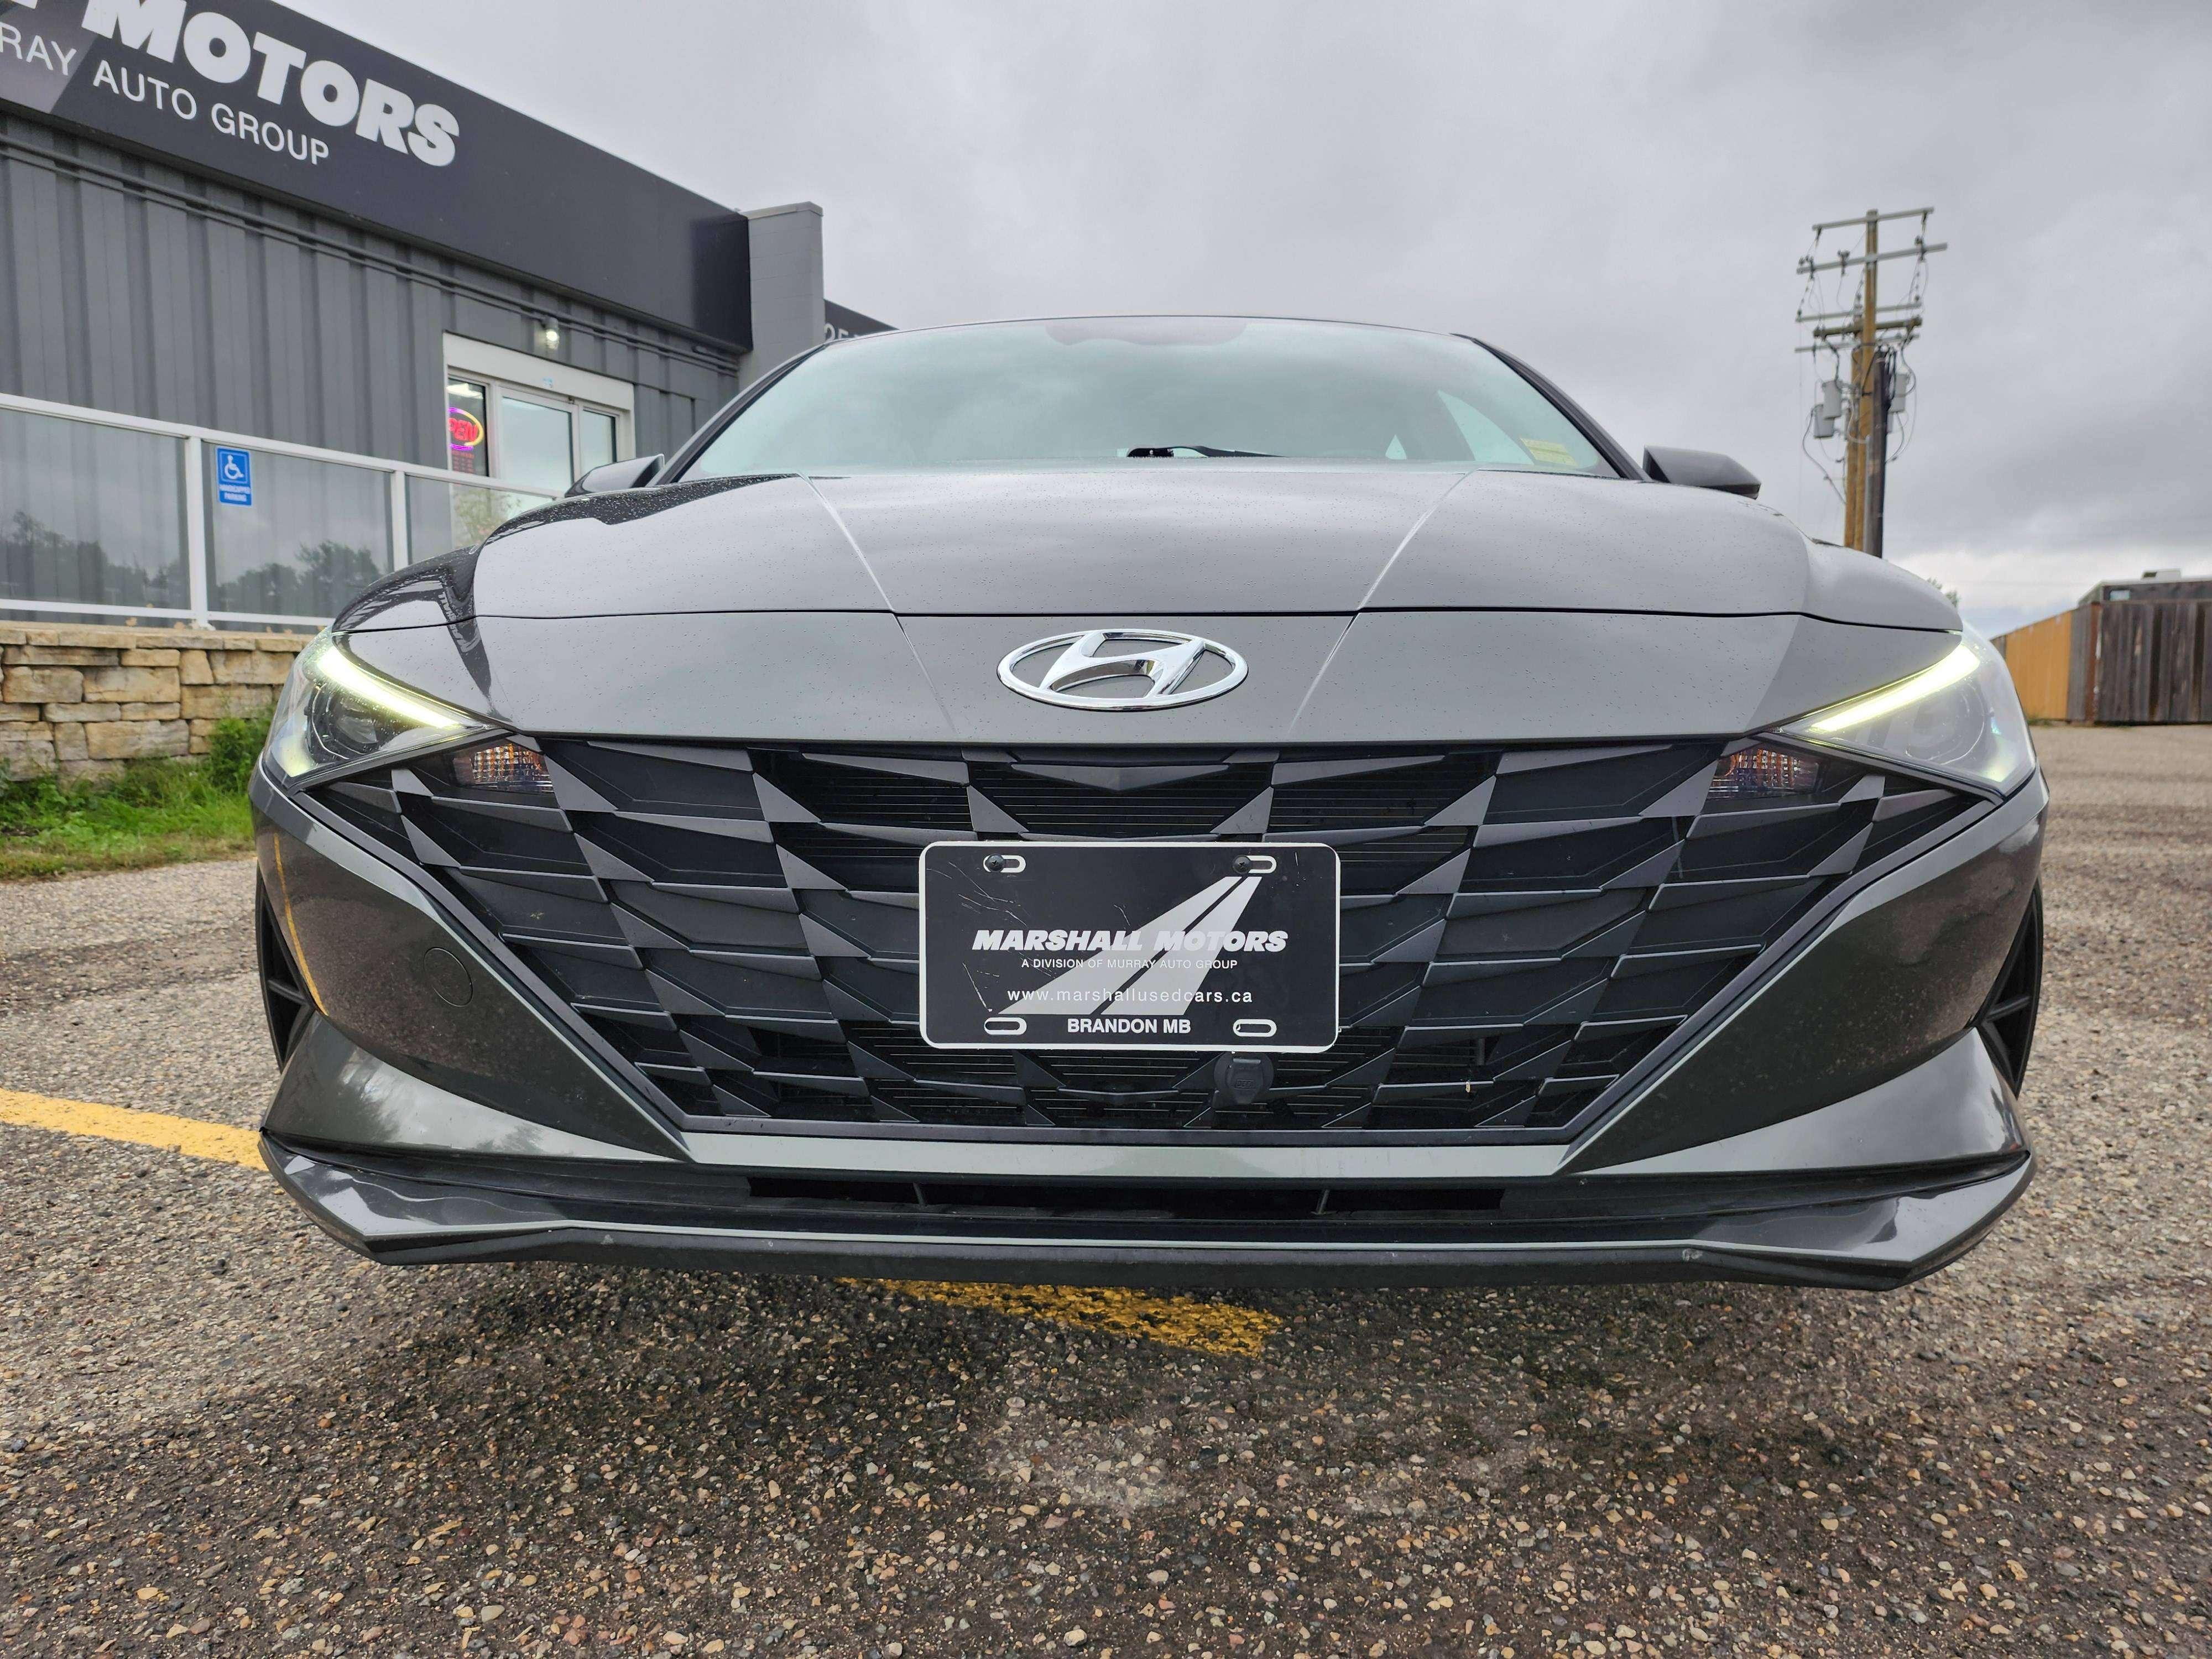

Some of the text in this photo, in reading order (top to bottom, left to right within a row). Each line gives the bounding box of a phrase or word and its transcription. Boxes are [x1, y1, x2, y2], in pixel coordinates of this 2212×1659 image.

[81, 0, 460, 167] MOTORS
[93, 59, 197, 120] AUTO
[211, 103, 330, 165] GROUP
[448, 418, 479, 442] PEN
[972, 929, 1289, 952] MARSHALL MOTORS
[1021, 958, 1238, 969] A DIVISION OF MURRAY AUTO GROUP
[1007, 988, 1253, 1003] www.marshallusedcars.ca
[1067, 1018, 1192, 1034] BRANDON MB
